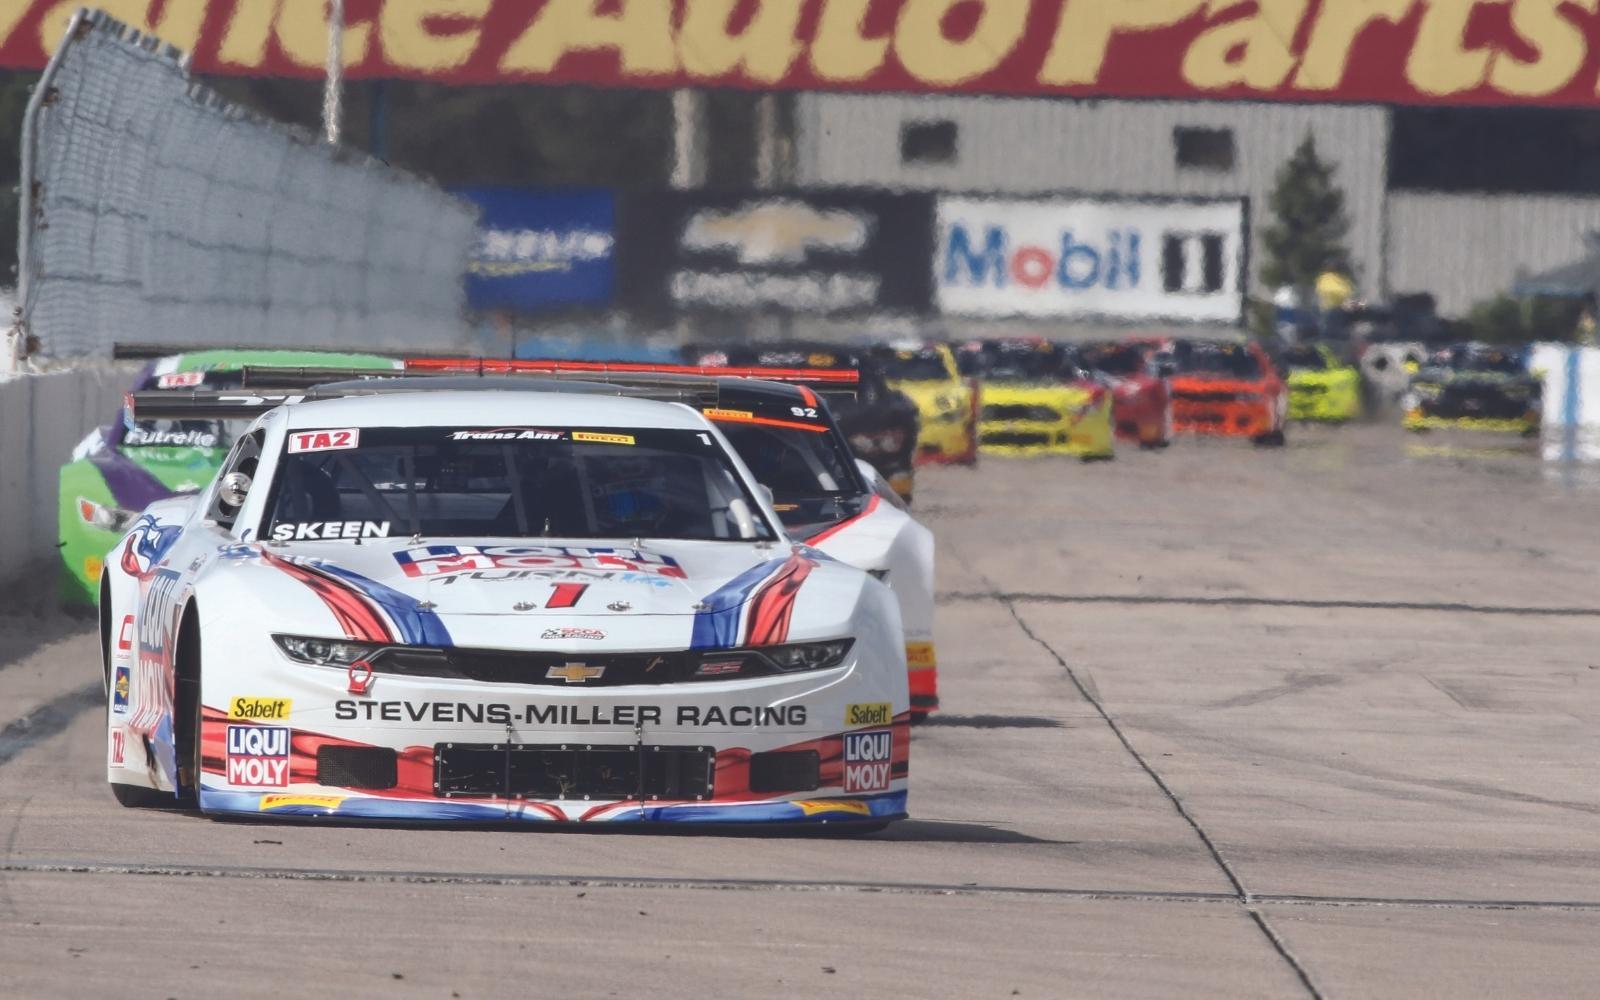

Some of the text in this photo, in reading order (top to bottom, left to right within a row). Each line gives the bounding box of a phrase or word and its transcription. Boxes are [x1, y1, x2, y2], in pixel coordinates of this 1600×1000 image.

[944, 222, 1142, 291] Mobil
[790, 406, 820, 419] 92
[297, 431, 352, 450] TA2
[450, 429, 562, 441] Trans Am
[696, 433, 712, 446] 1
[272, 520, 391, 542] SKEEN
[545, 582, 590, 609] 1
[234, 698, 285, 719] Sabelt
[675, 704, 808, 727] RACING
[850, 704, 888, 725] Sabelt
[229, 727, 288, 757] LIQUI
[845, 733, 891, 762] LIQUI
[229, 757, 289, 786] MOLY
[845, 763, 890, 792] MOLY
